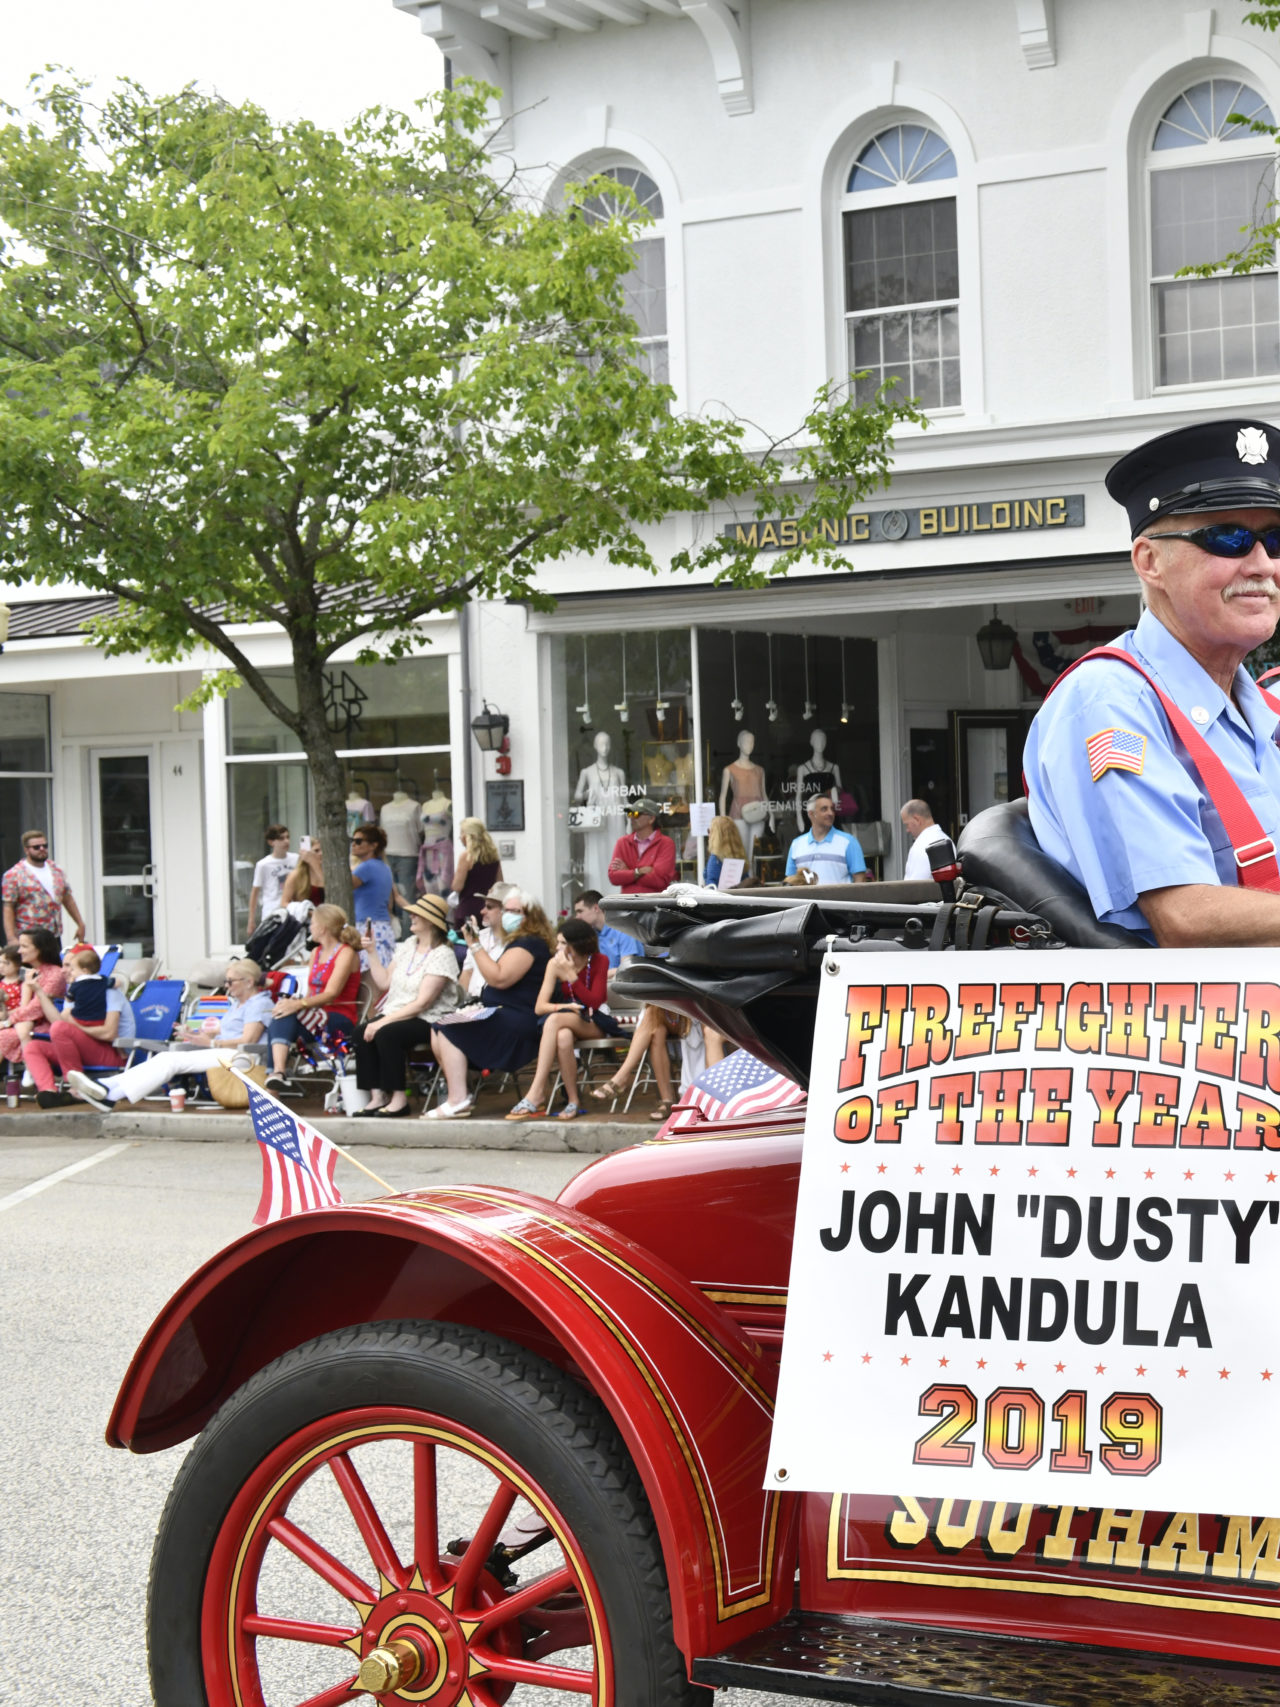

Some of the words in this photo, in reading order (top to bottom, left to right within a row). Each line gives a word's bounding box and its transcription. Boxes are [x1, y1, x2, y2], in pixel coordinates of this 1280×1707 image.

[919, 498, 1068, 535] BUILDING
[600, 784, 647, 797] URBAN
[760, 799, 842, 812] RENAISSE
[781, 782, 821, 793] URBAN
[834, 1079, 919, 1144] OF
[929, 1067, 1074, 1147] THE
[819, 1189, 996, 1256] JOHN
[884, 1273, 1213, 1349] KANDULA
[912, 1382, 1163, 1477] 2019
